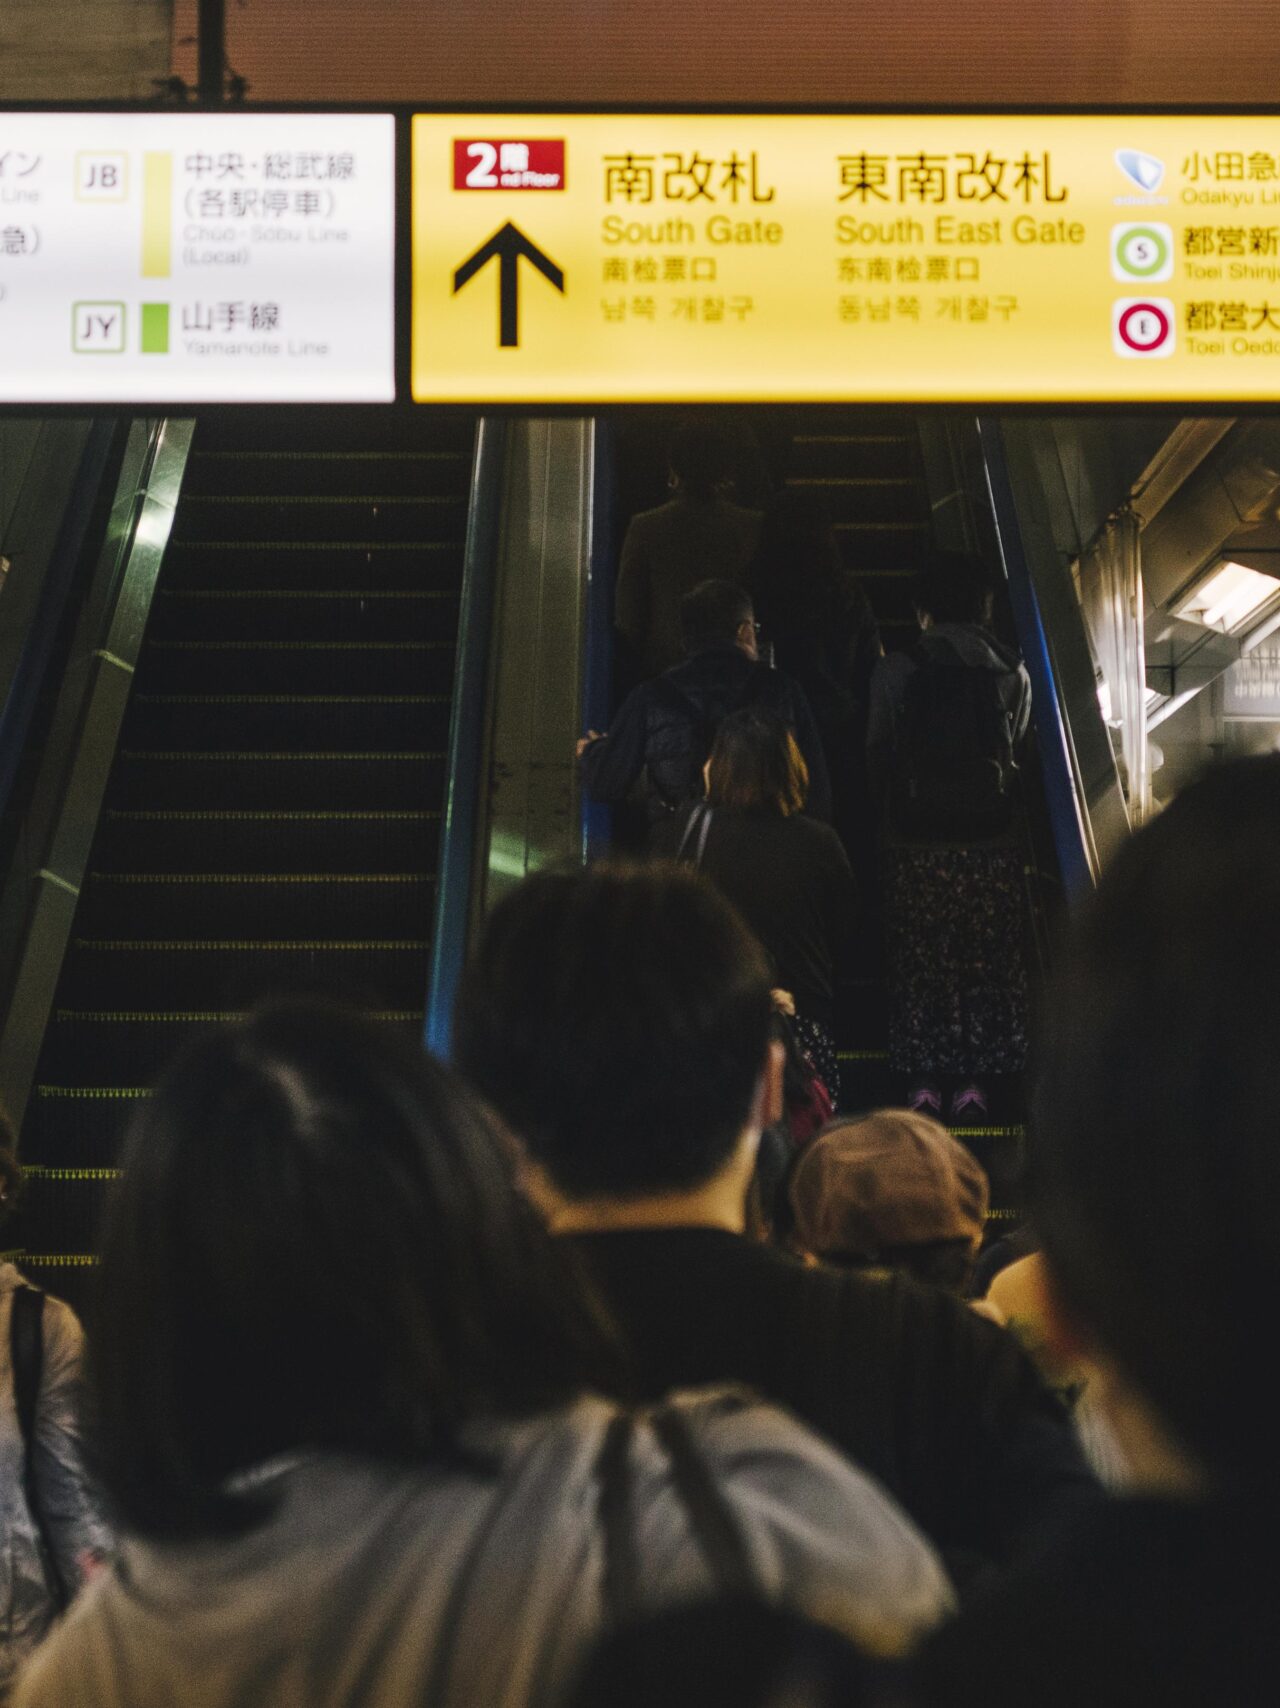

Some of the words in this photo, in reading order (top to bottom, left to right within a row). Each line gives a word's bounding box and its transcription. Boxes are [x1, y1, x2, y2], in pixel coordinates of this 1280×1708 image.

[86, 165, 117, 189] JB
[184, 150, 356, 180] 中央・総武線
[601, 151, 774, 203] 南改札
[836, 151, 1068, 203] 東南改札
[184, 188, 336, 218] (各駅停車)
[1181, 188, 1255, 207] Odakyu
[307, 225, 349, 243] Line
[601, 214, 695, 244] South
[705, 214, 784, 244] Gate
[835, 214, 925, 244] South
[934, 214, 1004, 244] East
[1011, 214, 1086, 244] Gate
[183, 246, 250, 267] (Local)
[601, 255, 719, 283] 南检票口
[837, 255, 981, 283] 东南检票口
[1184, 262, 1223, 280] Toei
[82, 315, 118, 340] JY
[182, 302, 280, 332] 山手線
[184, 339, 280, 357] Yamanote
[287, 339, 330, 356] Line
[1186, 338, 1225, 355] Toei
